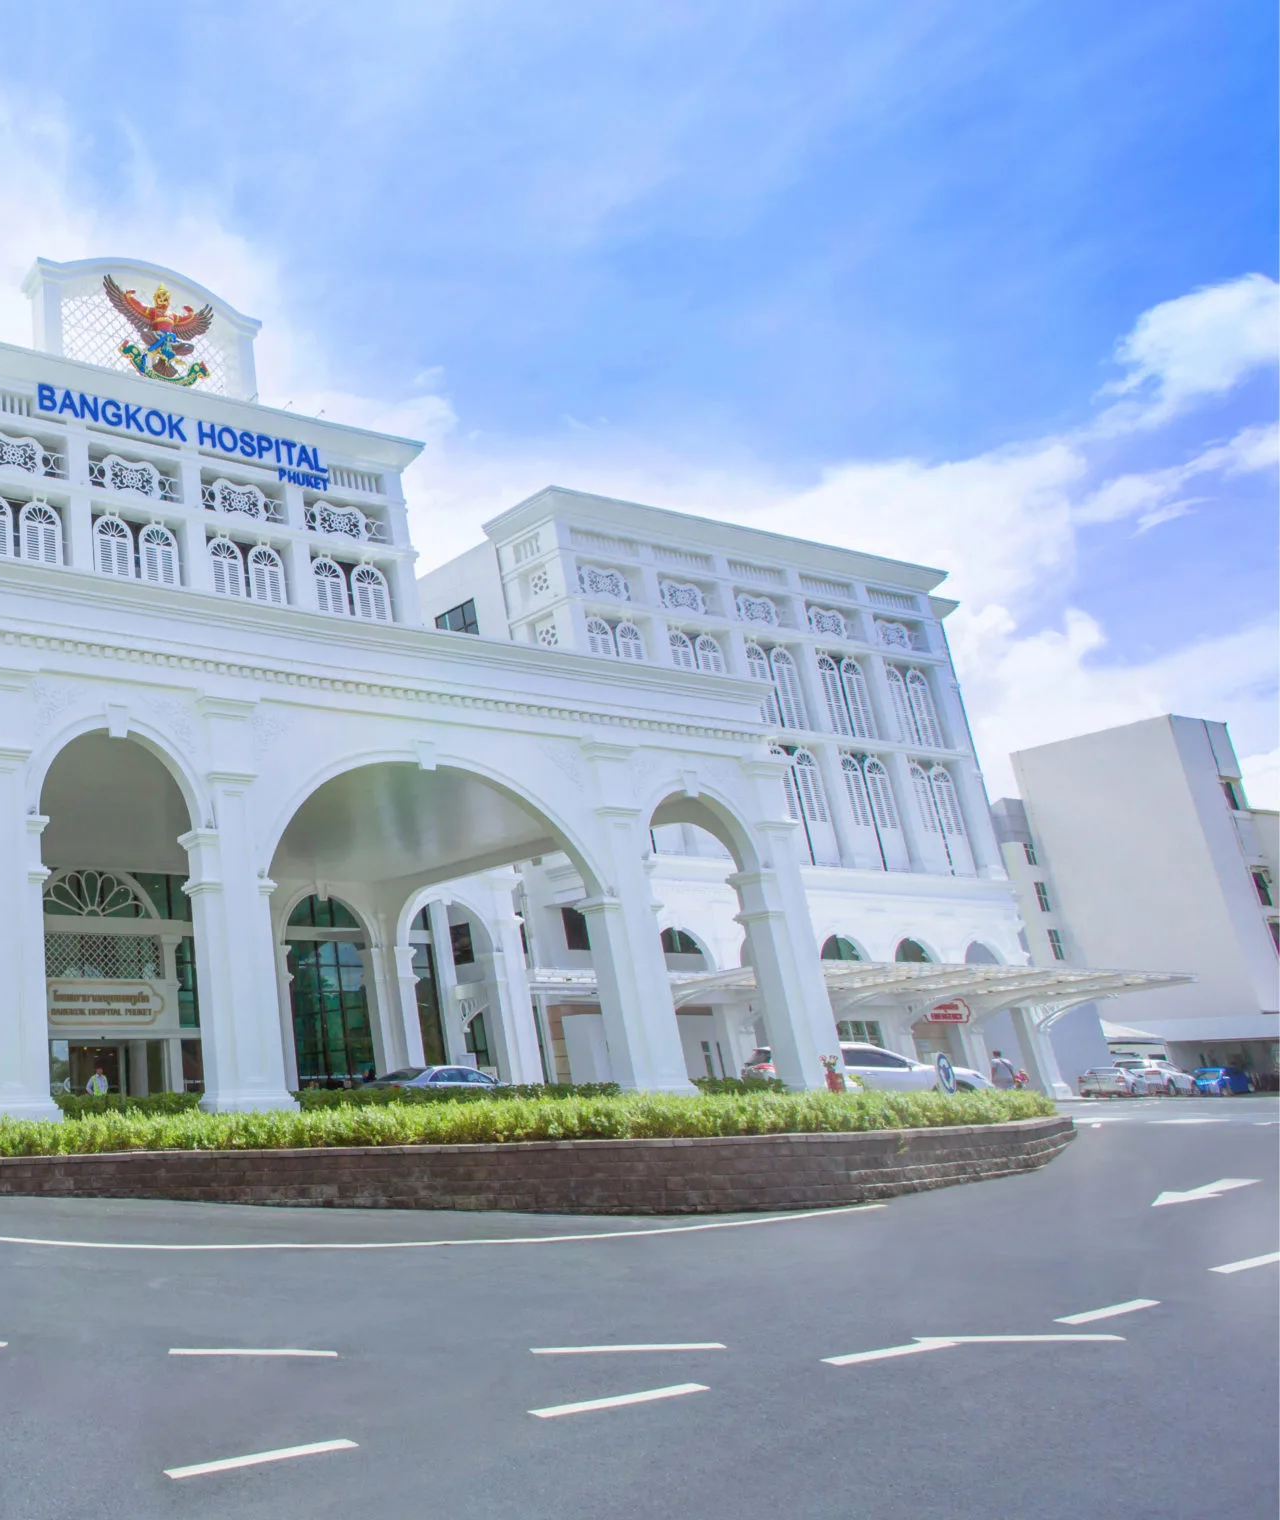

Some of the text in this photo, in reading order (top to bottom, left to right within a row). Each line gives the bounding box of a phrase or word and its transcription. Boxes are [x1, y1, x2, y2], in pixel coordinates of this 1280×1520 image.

[37, 383, 329, 473] BANGKOK HOSPITAL
[277, 467, 329, 491] PHUKET
